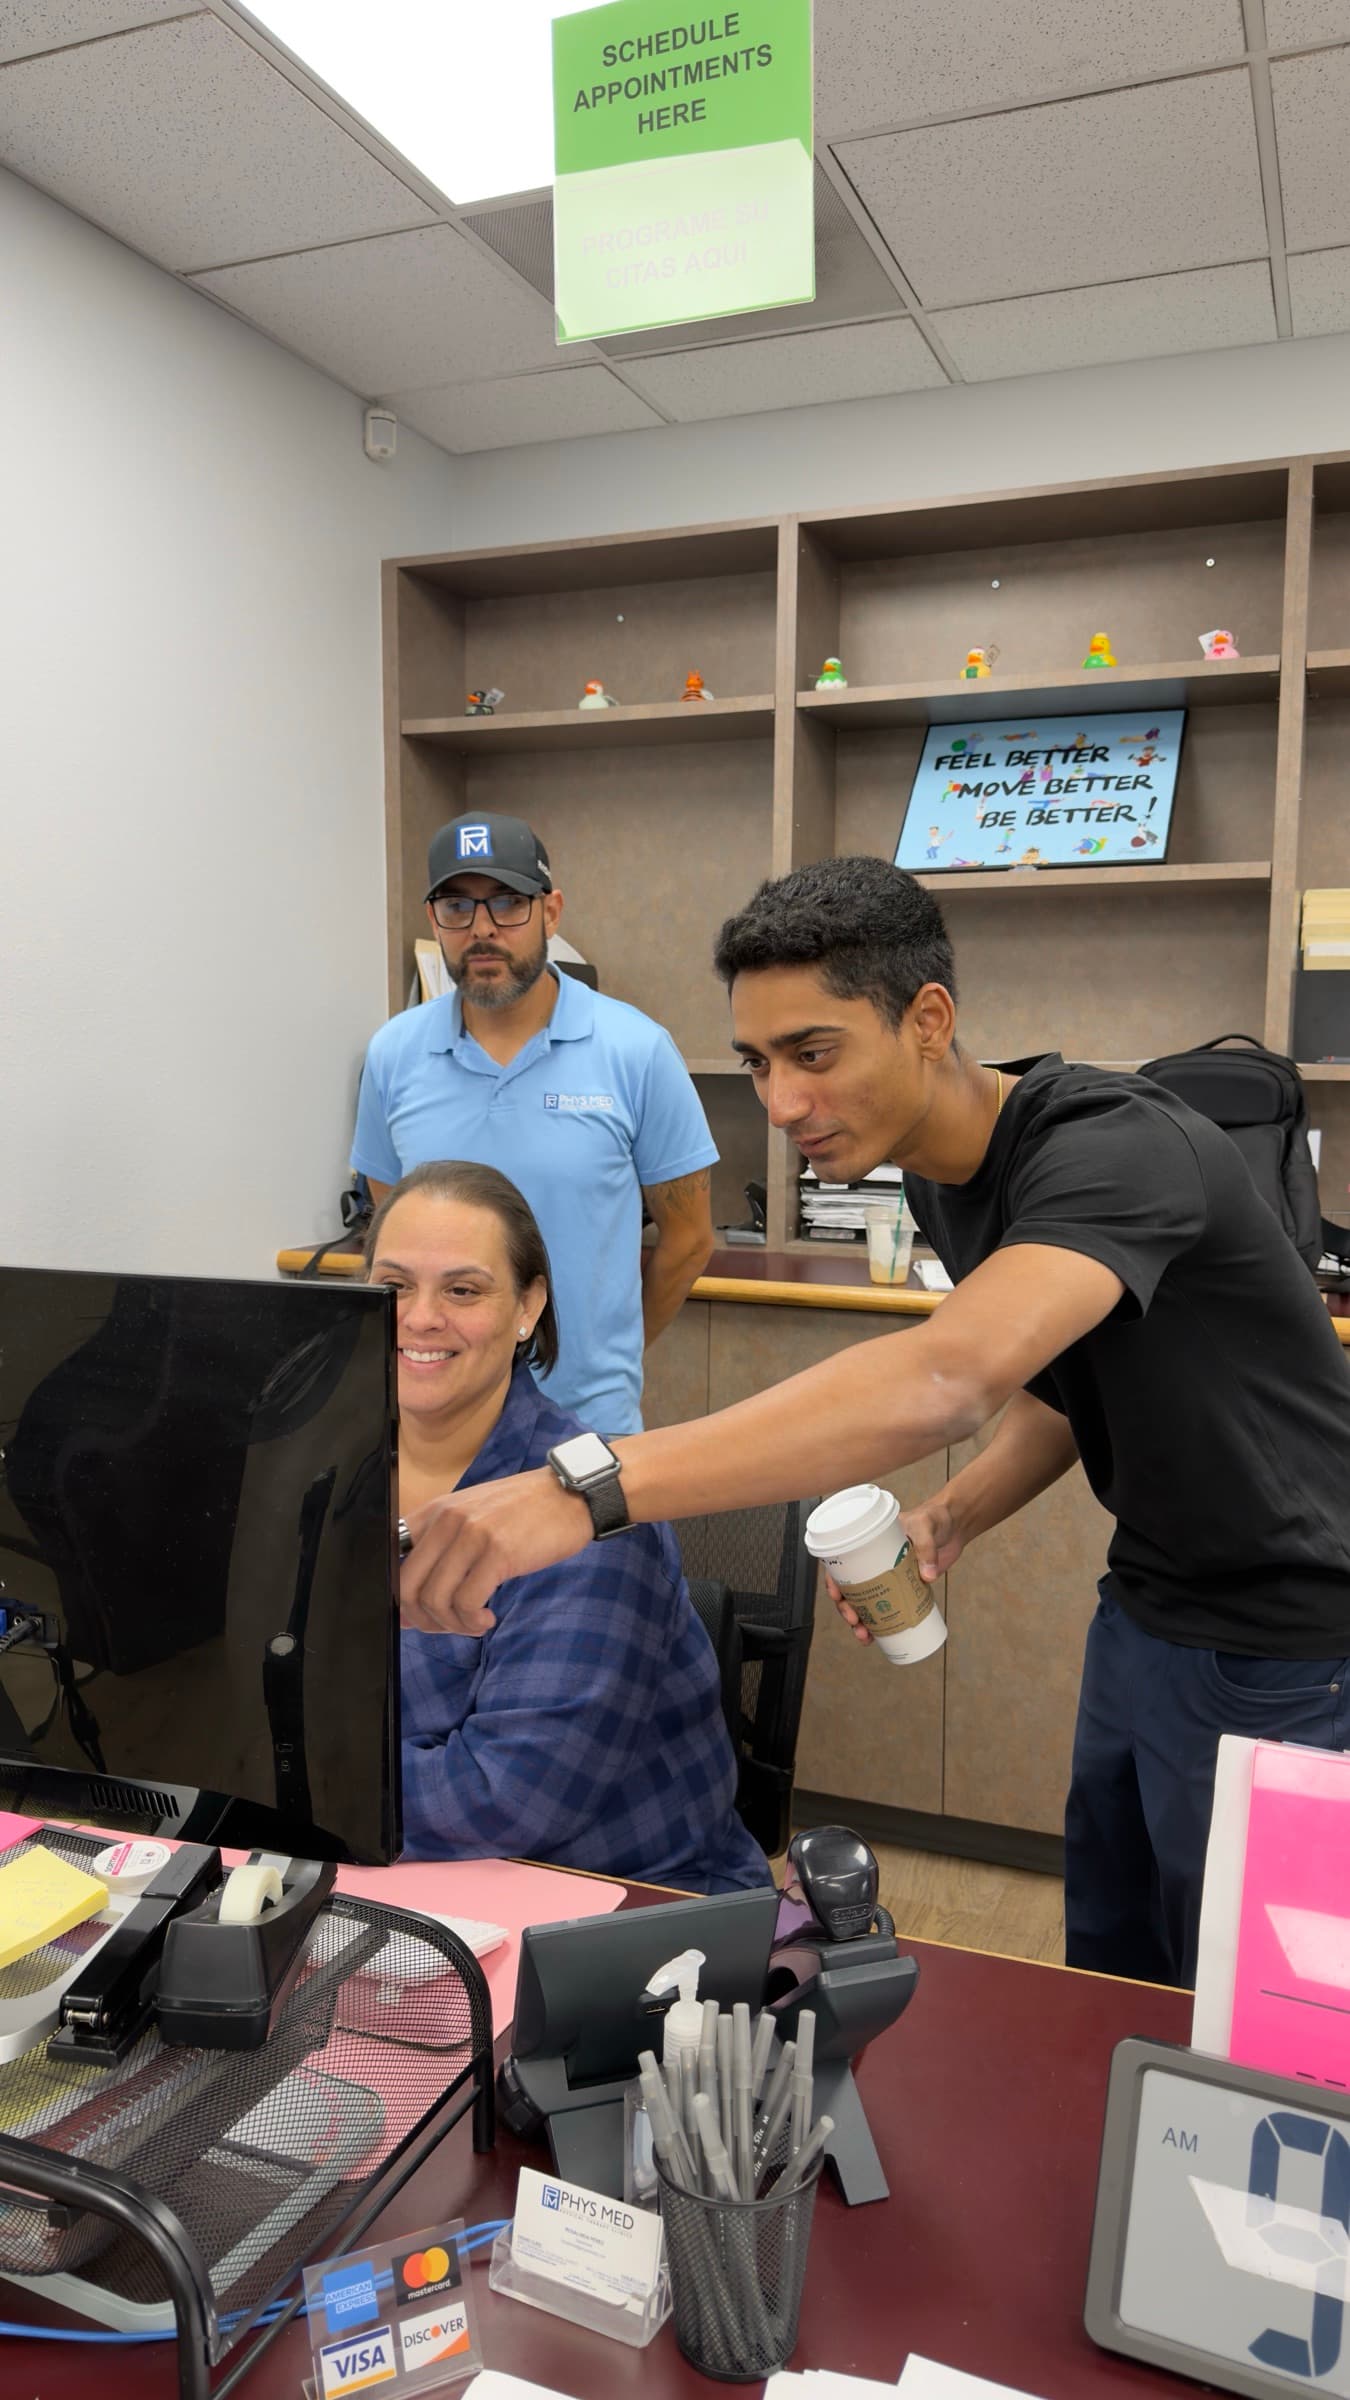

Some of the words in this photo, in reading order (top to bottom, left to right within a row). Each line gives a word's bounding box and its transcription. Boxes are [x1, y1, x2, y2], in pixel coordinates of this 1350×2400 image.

[602, 12, 740, 67] SCHEDULE
[573, 44, 773, 113] APPOINTMENTS
[638, 98, 706, 134] HERE
[581, 207, 727, 258] PROGRAME
[605, 255, 676, 289] CITAS
[934, 752, 996, 771] FEEL
[1005, 745, 1110, 767] BETTER
[957, 779, 1036, 799] MOVE
[1043, 774, 1153, 795] BETTER
[980, 811, 1016, 829] BE
[589, 1095, 614, 1106] MED
[1161, 2127, 1198, 2153] AM
[561, 2191, 597, 2217] PHYS
[601, 2205, 634, 2230] MED
[325, 2279, 372, 2304] AMERICAN
[336, 2291, 376, 2314] EXPRESS
[408, 2278, 451, 2300] mastercard
[404, 2316, 464, 2348] DISCOVER
[331, 2345, 386, 2379] VISA
